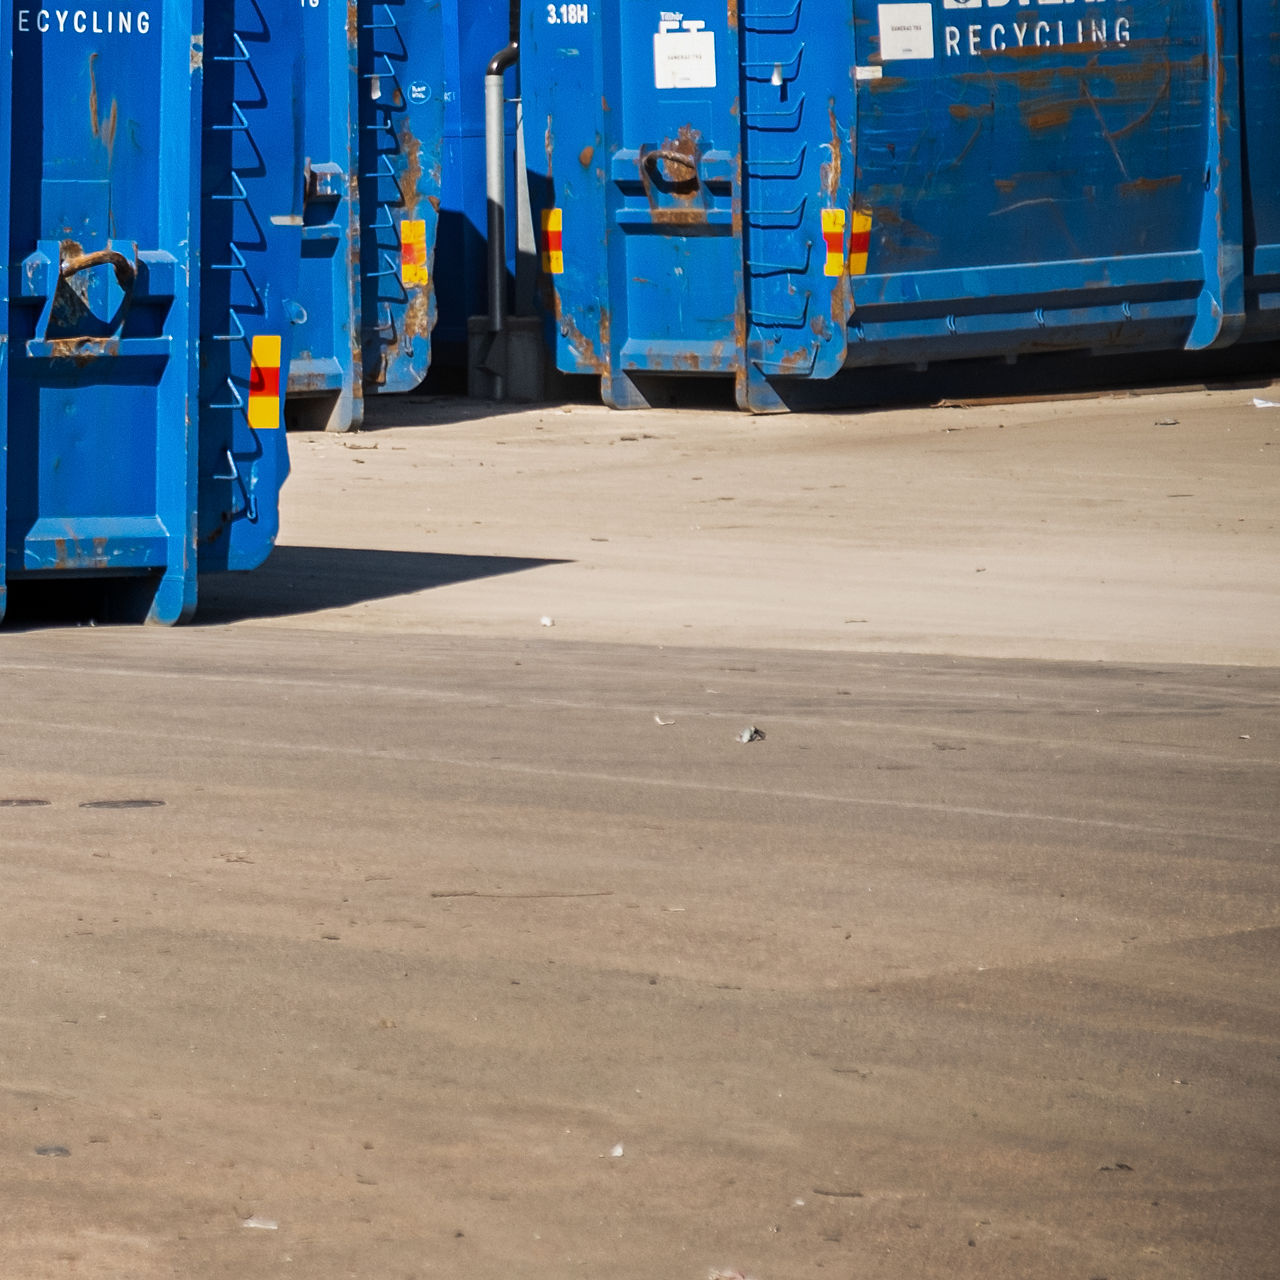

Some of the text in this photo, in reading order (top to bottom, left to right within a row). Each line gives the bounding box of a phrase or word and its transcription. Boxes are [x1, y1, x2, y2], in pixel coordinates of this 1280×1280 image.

[18, 9, 150, 34] ECYCLING
[546, 3, 588, 24] 3.18H
[945, 17, 1130, 57] RECYCLING
